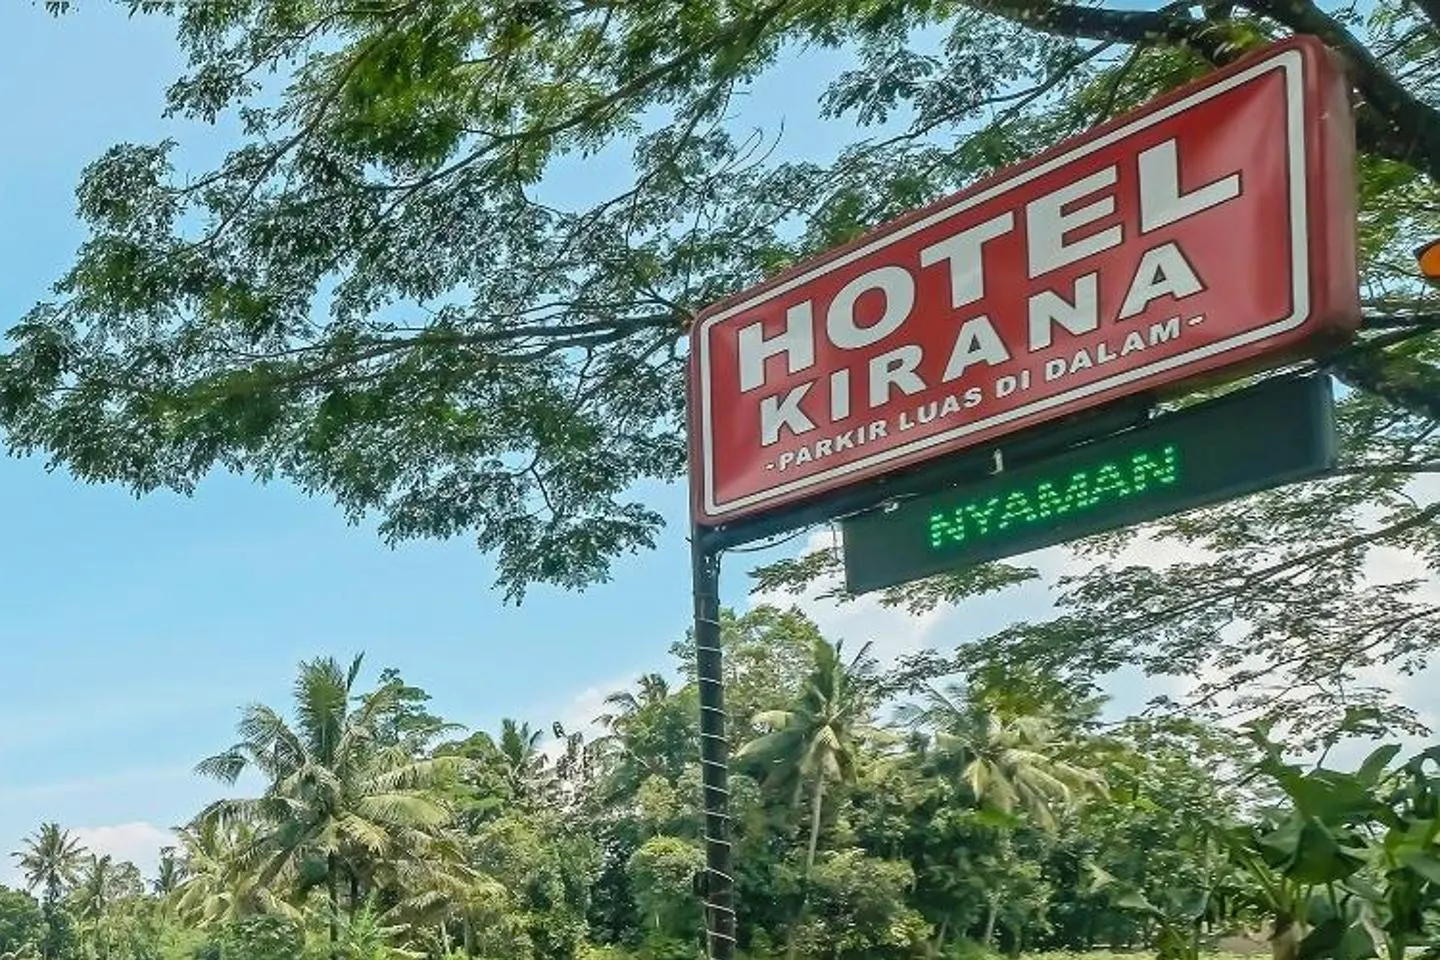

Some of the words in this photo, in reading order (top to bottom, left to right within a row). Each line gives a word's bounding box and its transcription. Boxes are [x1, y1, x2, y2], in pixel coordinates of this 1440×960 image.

[738, 138, 1242, 392] HOTEL
[760, 242, 1207, 447] KIRANA
[899, 387, 982, 431] LUAS
[995, 370, 1030, 399] DI
[929, 445, 1176, 547] NYAMAN
